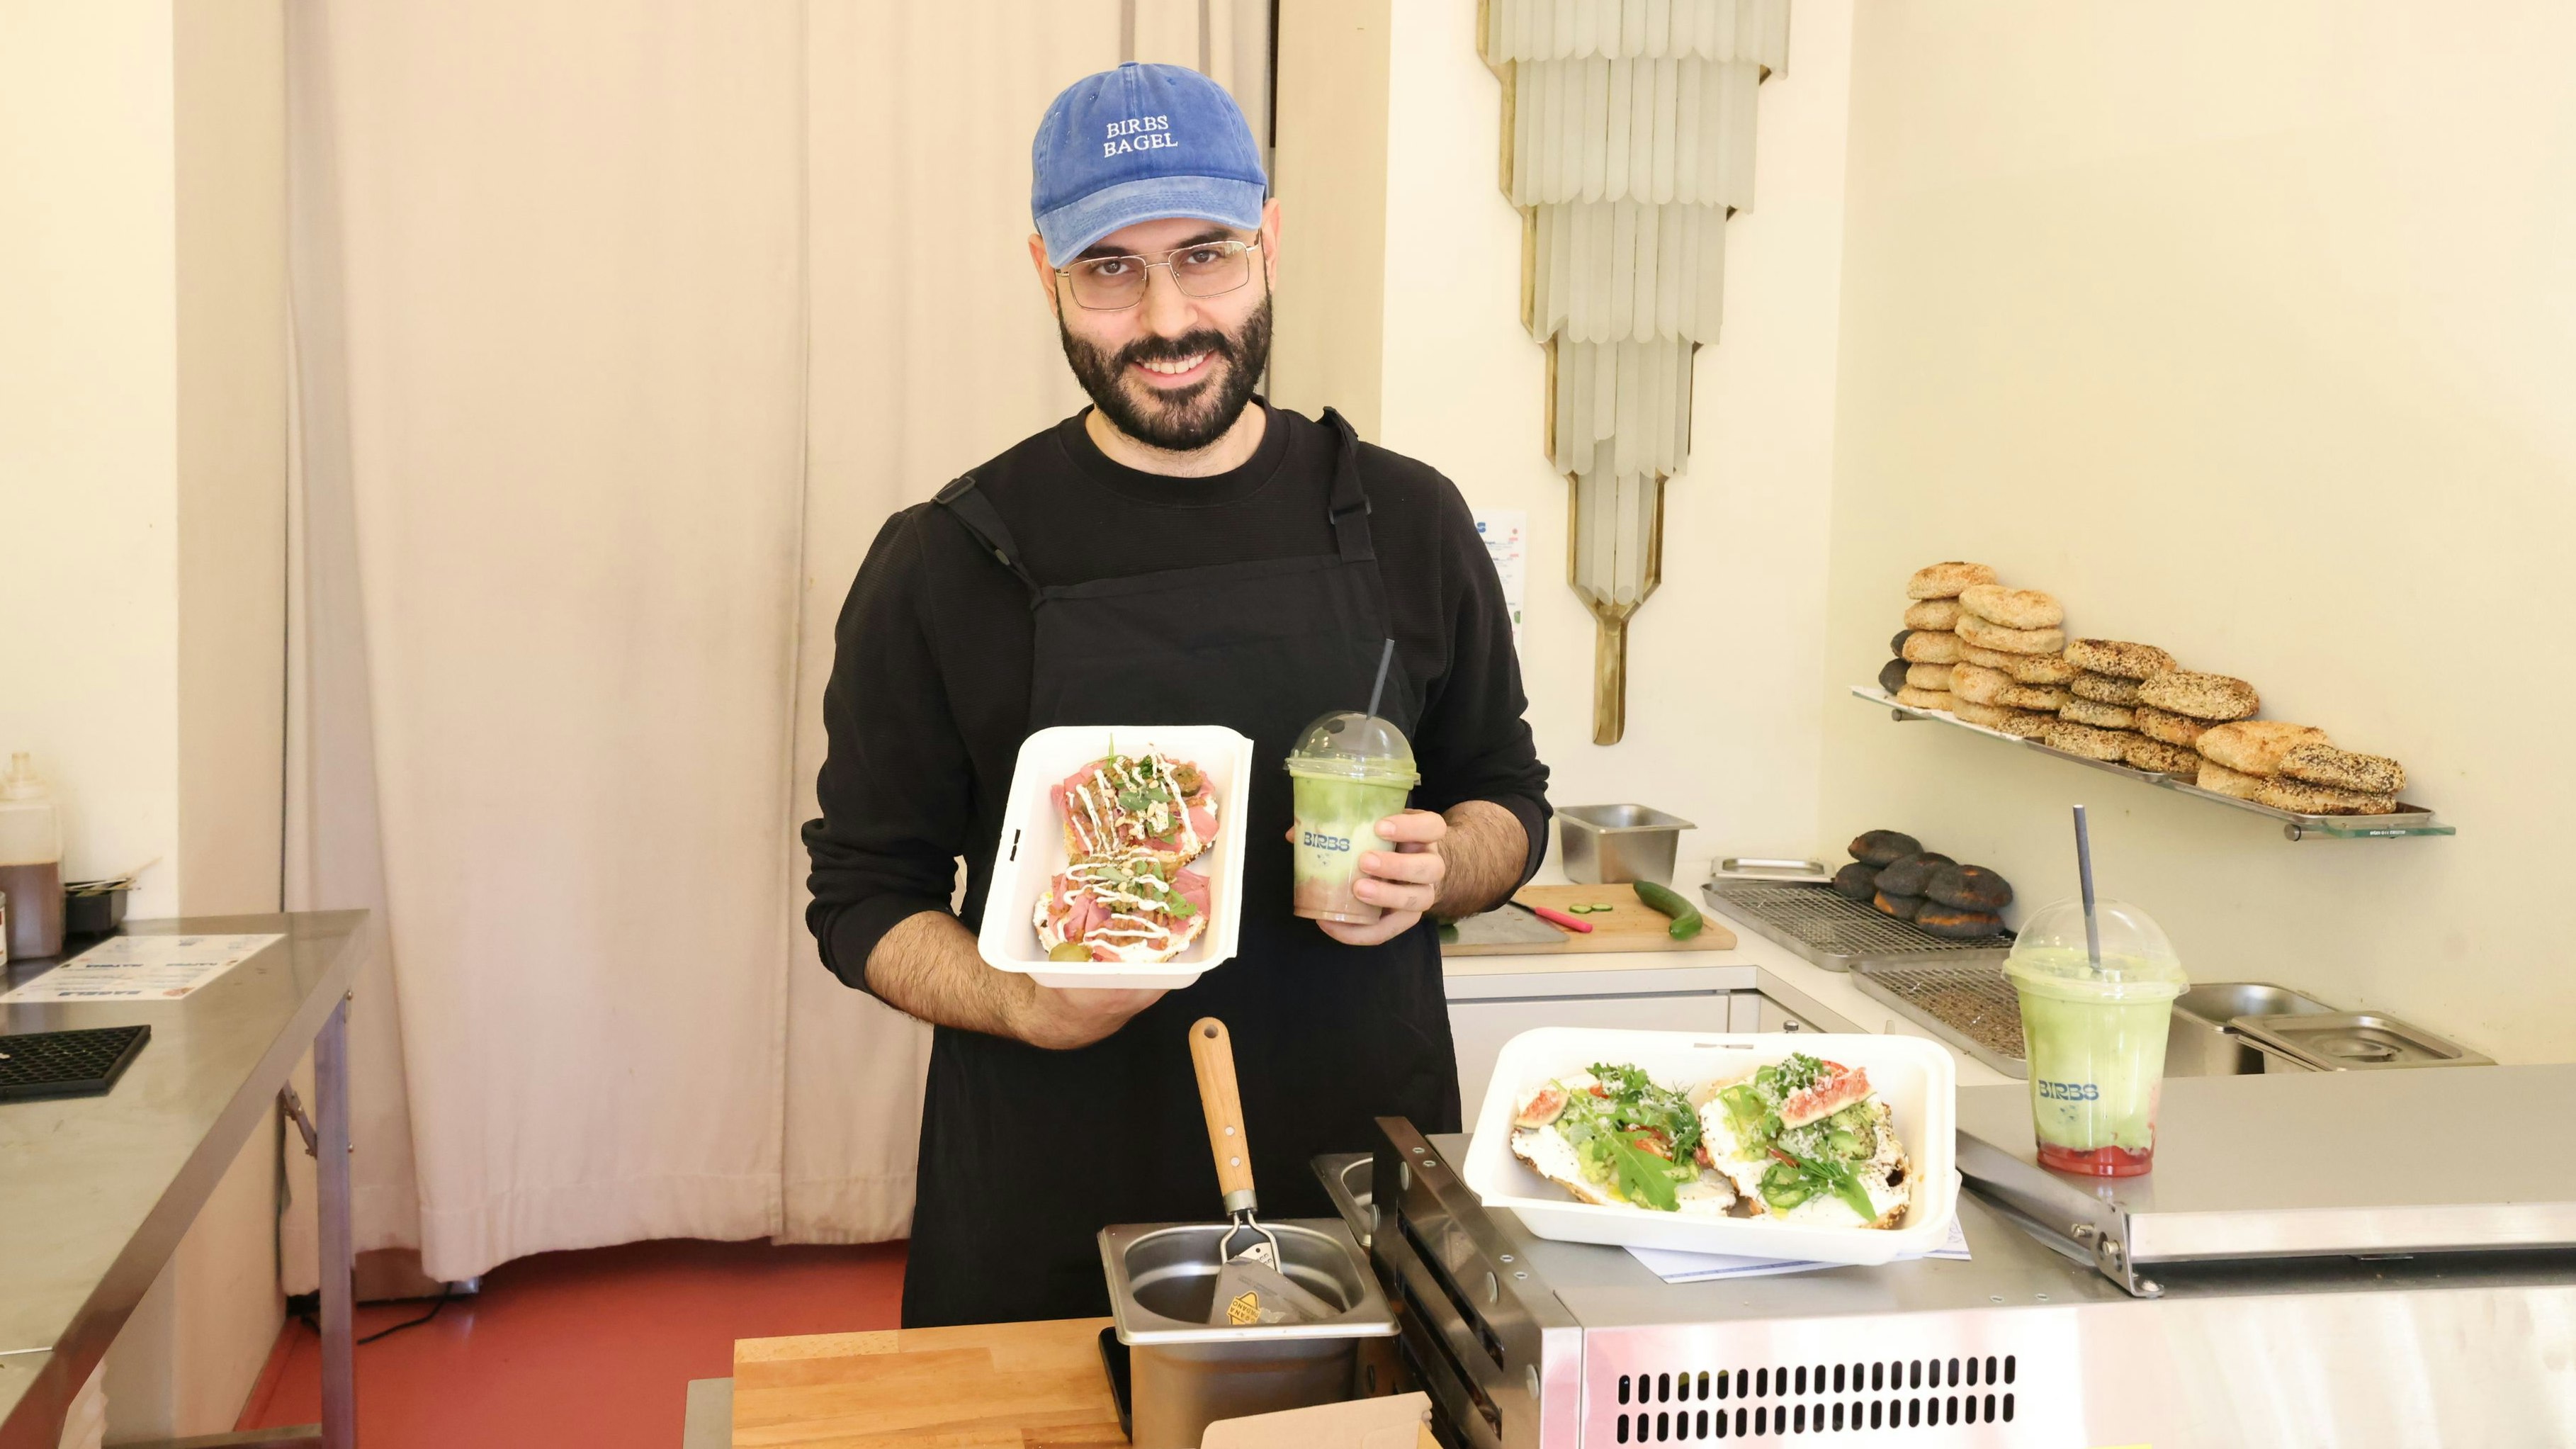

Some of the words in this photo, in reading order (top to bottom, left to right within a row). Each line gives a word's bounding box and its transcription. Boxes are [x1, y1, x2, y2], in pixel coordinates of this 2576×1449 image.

[1107, 114, 1169, 139] BIRBS
[1103, 133, 1178, 158] BAGEL
[1304, 831, 1350, 852] BIRBS
[2038, 1079, 2099, 1101] BIRBS
[1232, 1300, 1259, 1318] PADANO
